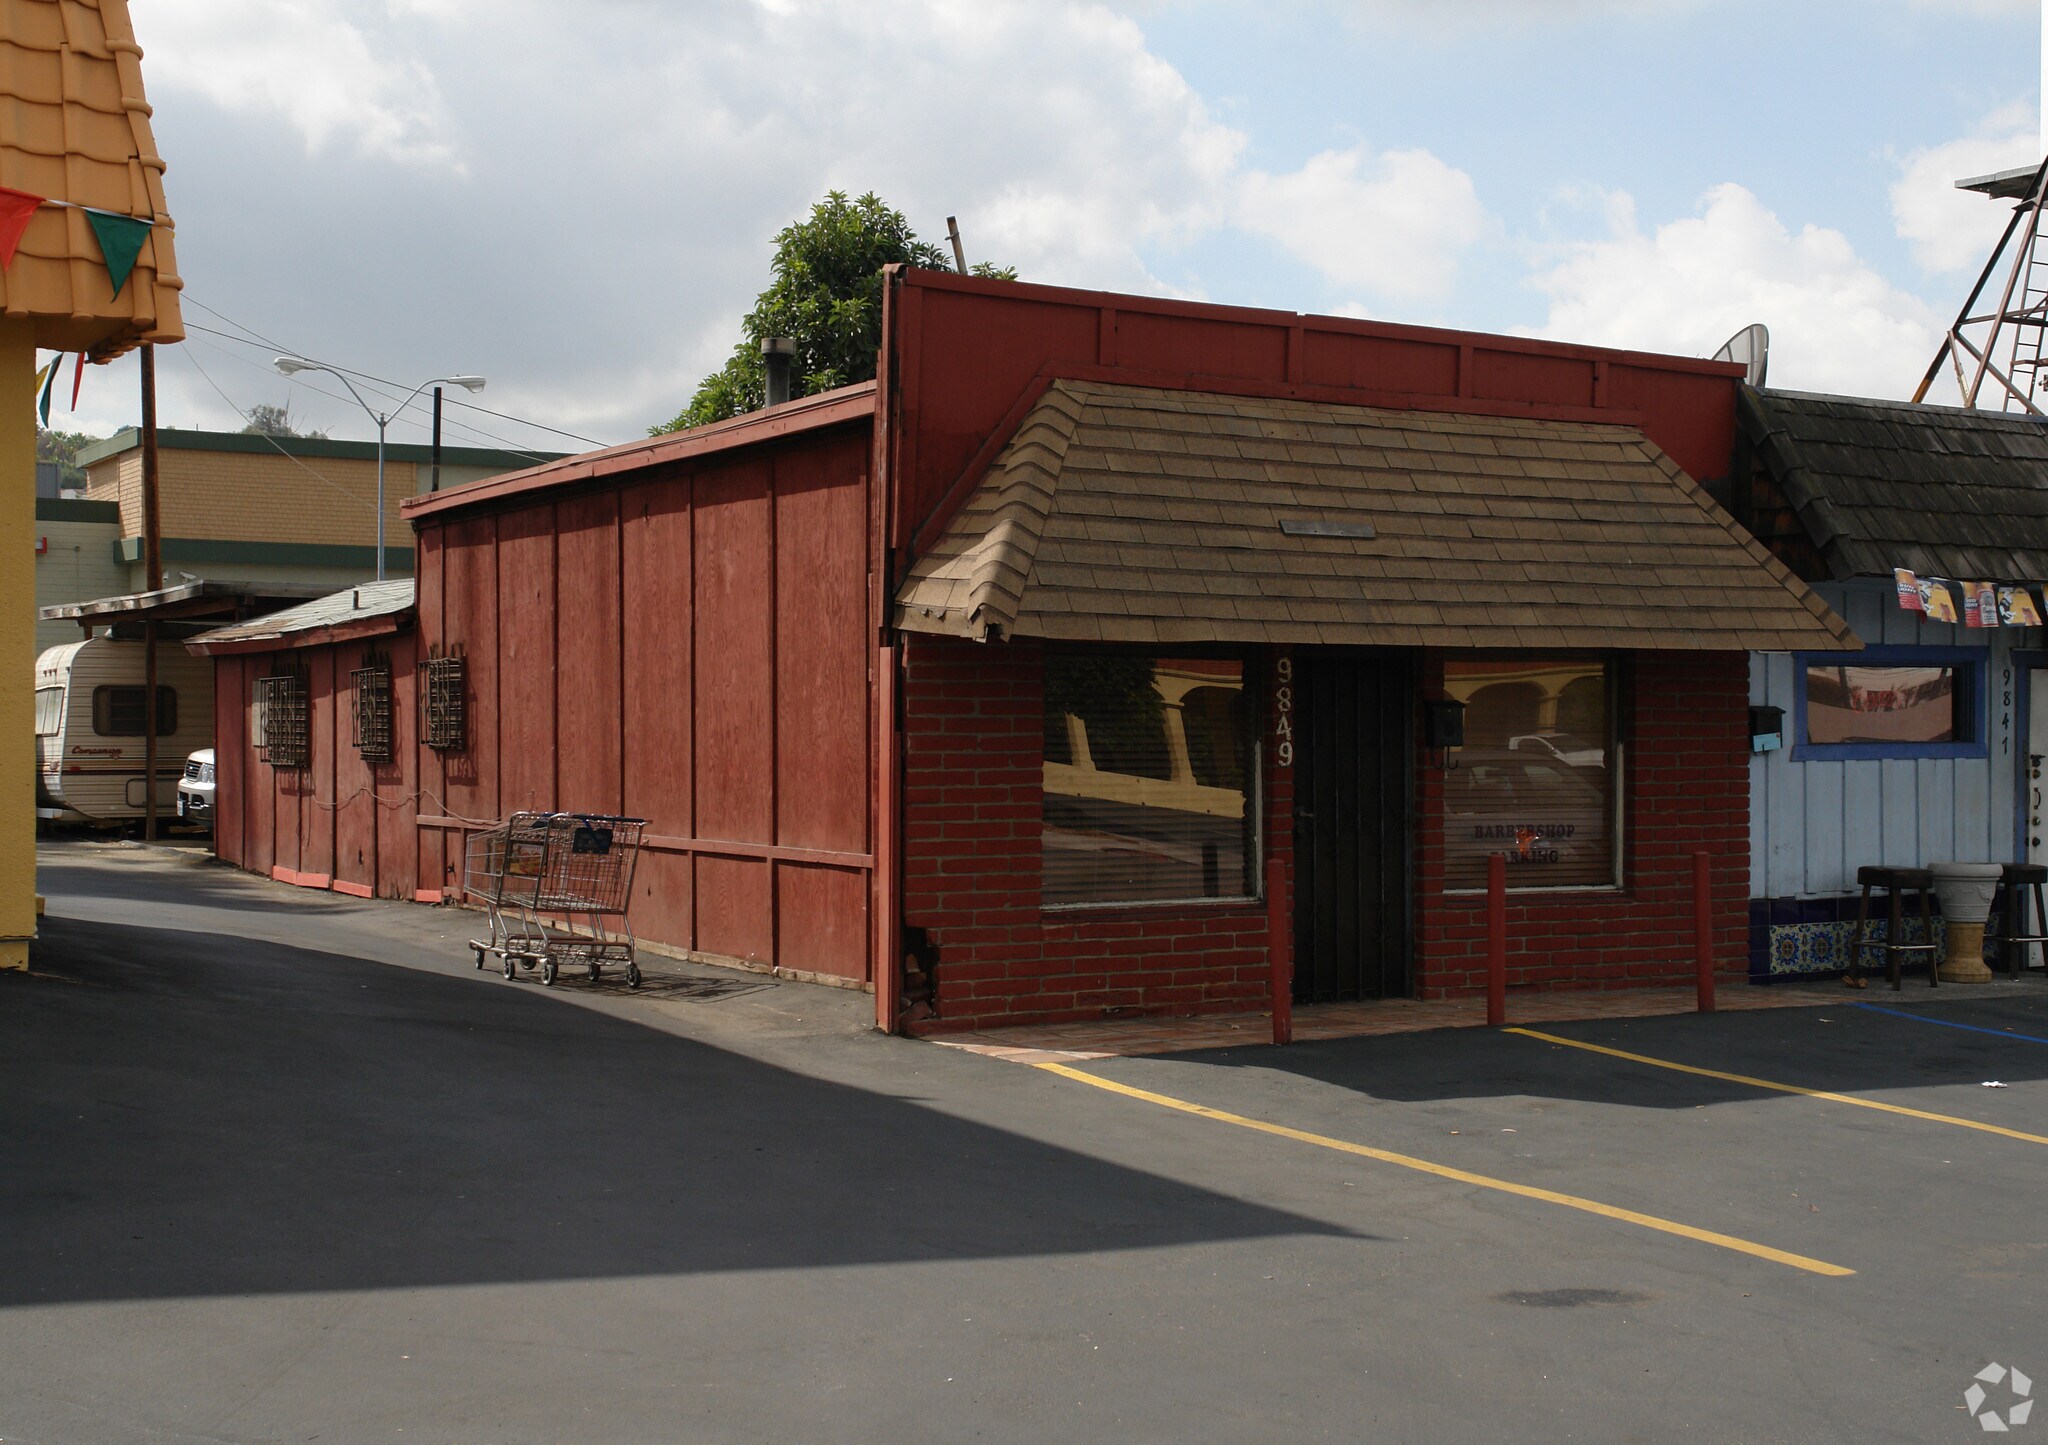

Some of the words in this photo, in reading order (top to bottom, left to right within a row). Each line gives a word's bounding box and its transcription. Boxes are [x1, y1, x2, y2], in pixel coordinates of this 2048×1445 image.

[1276, 657, 1293, 767] 9849
[2002, 669, 2011, 754] 9841
[1491, 851, 1559, 864] ARKING
